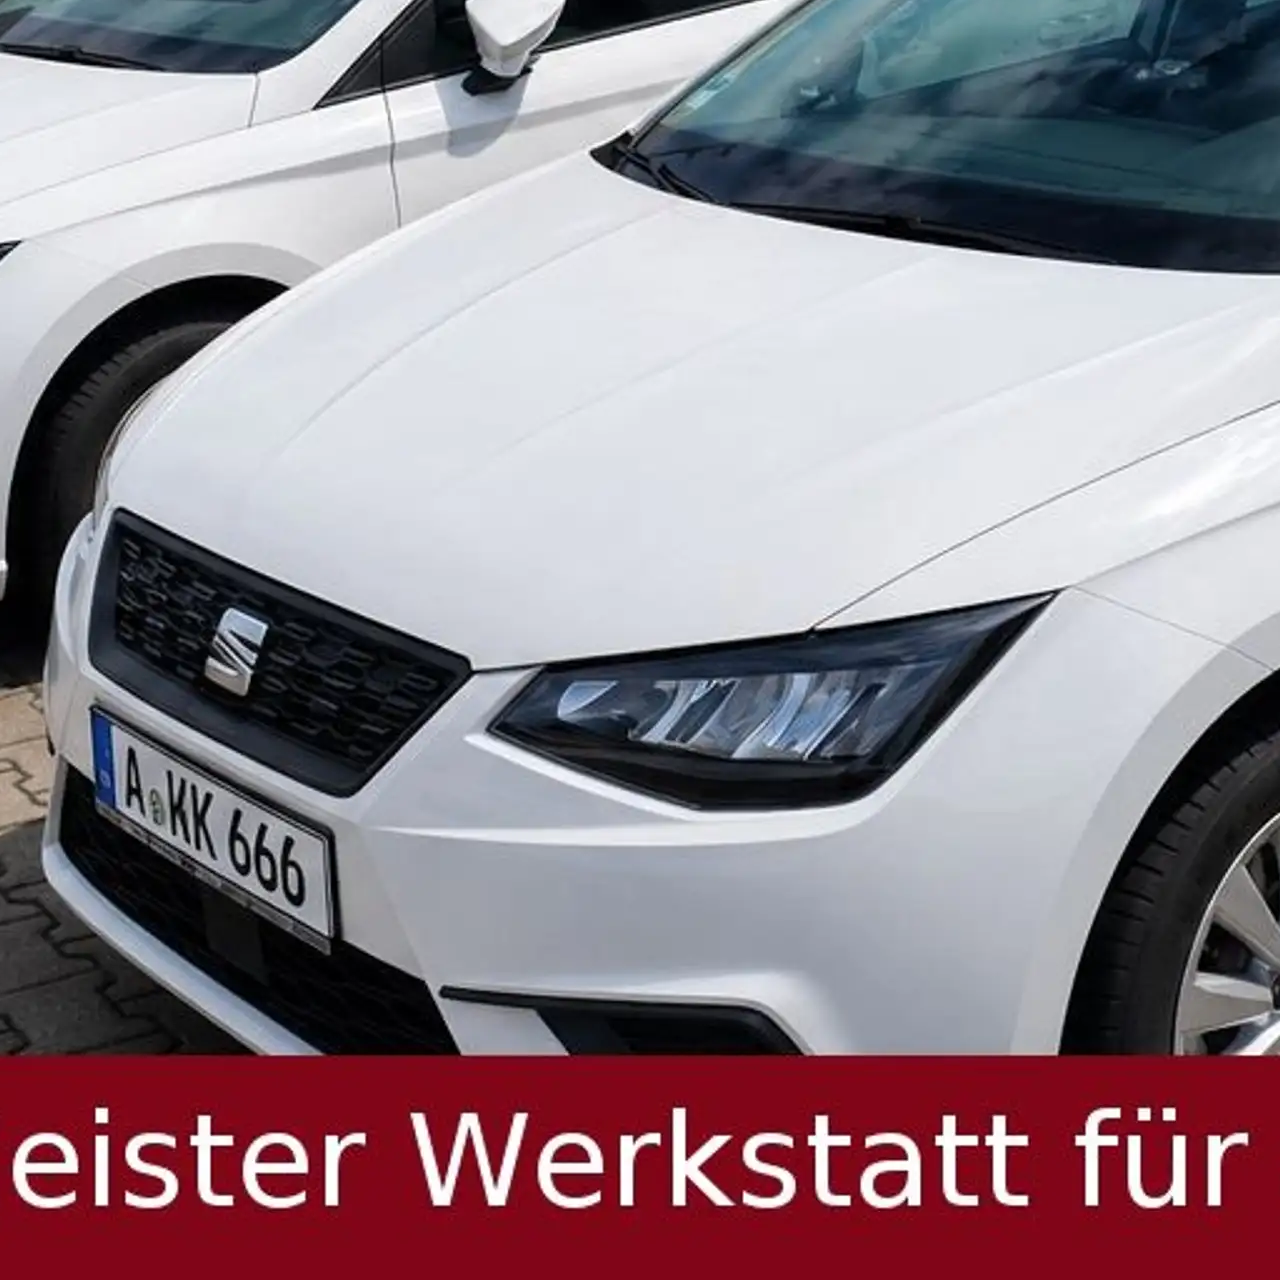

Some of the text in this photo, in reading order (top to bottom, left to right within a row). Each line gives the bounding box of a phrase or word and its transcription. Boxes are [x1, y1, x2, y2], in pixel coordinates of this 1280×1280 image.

[125, 746, 306, 908] A KK 666
